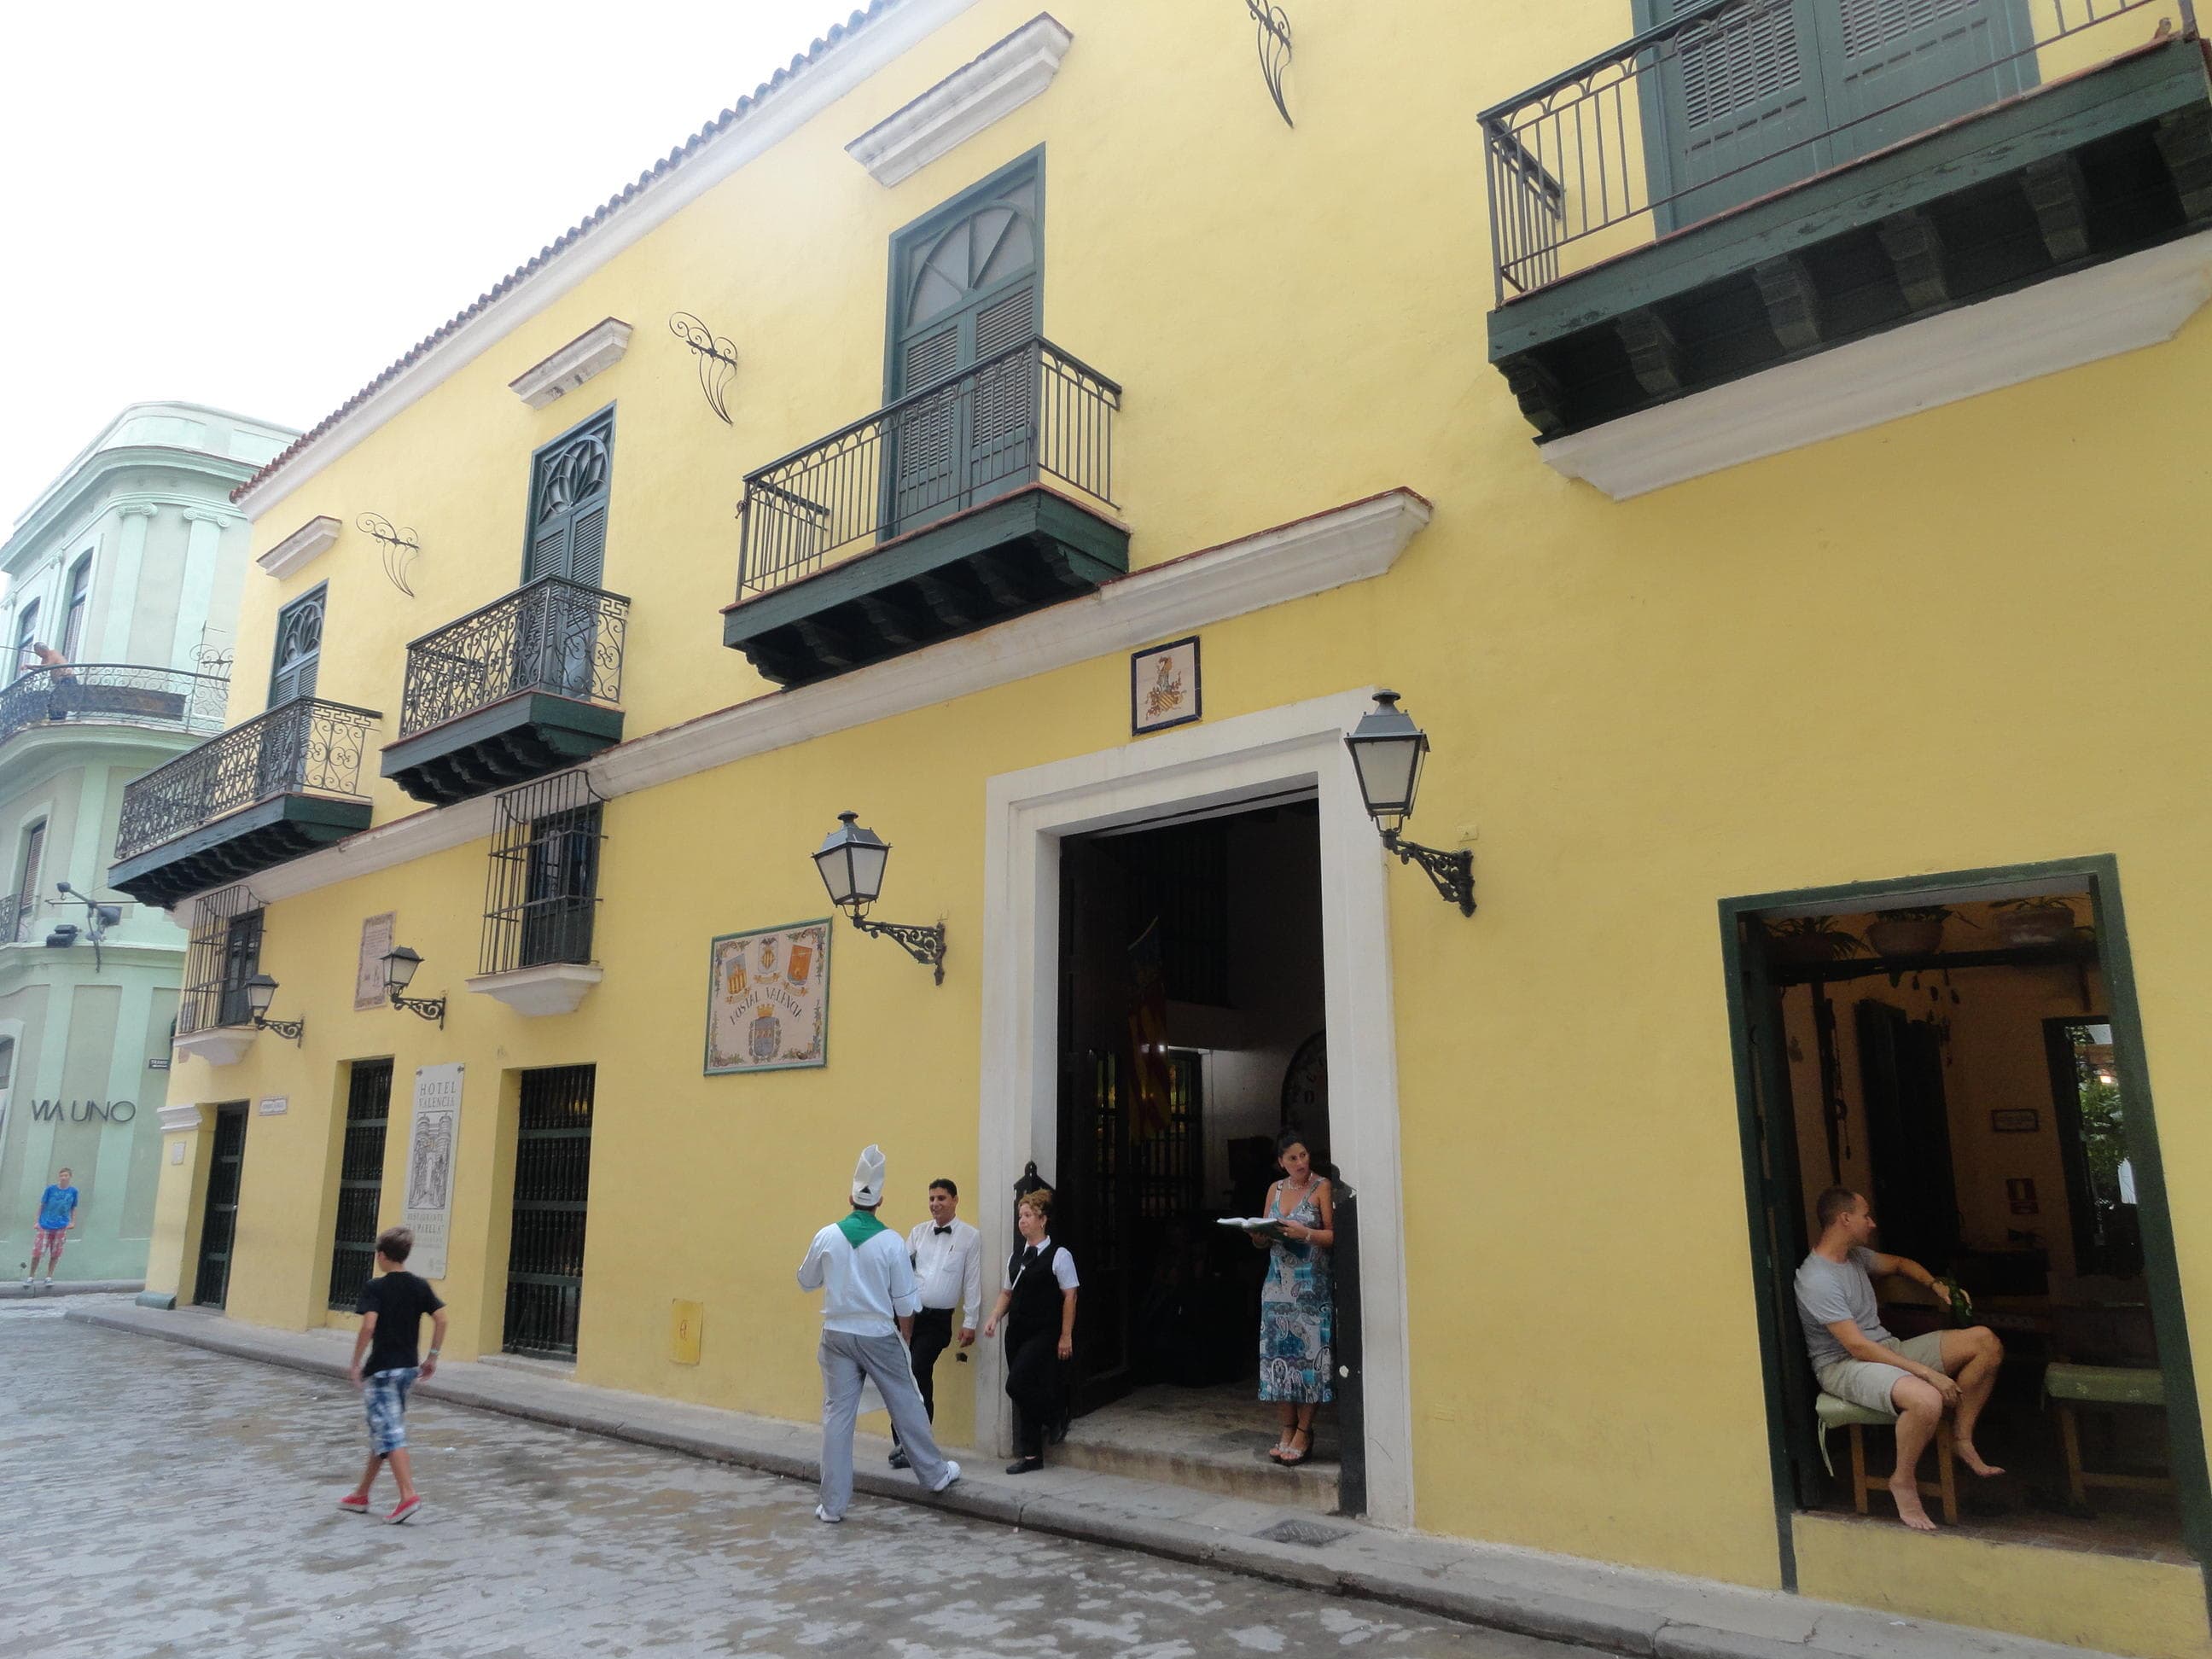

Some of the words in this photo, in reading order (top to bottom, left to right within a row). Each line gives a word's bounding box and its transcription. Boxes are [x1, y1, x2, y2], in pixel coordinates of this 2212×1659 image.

[419, 1080, 457, 1096] HOTEL
[418, 1096, 455, 1108] VALENCIA
[32, 1099, 65, 1121] VIA
[71, 1100, 136, 1122] UNO
